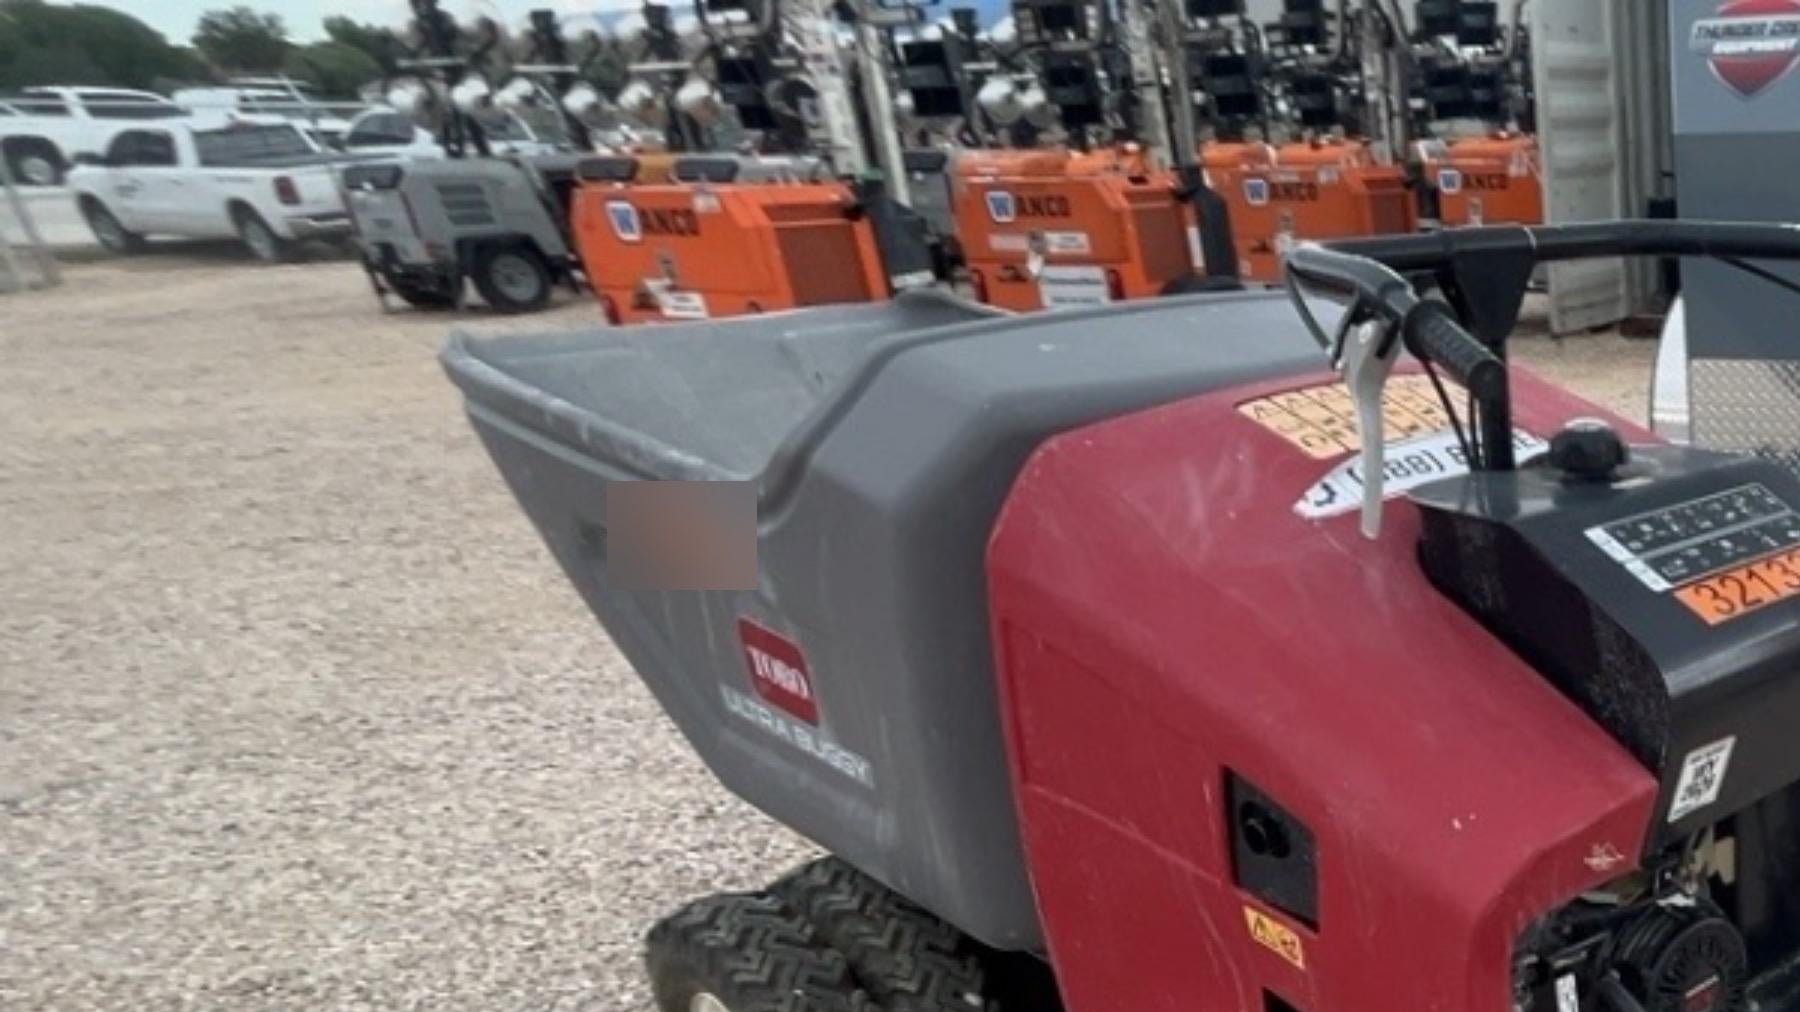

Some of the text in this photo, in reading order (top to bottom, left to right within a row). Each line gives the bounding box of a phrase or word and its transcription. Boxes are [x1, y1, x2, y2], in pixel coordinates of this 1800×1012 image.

[608, 202, 700, 239] WANCO
[1347, 449, 1445, 493] (88)
[747, 645, 810, 699] TORO
